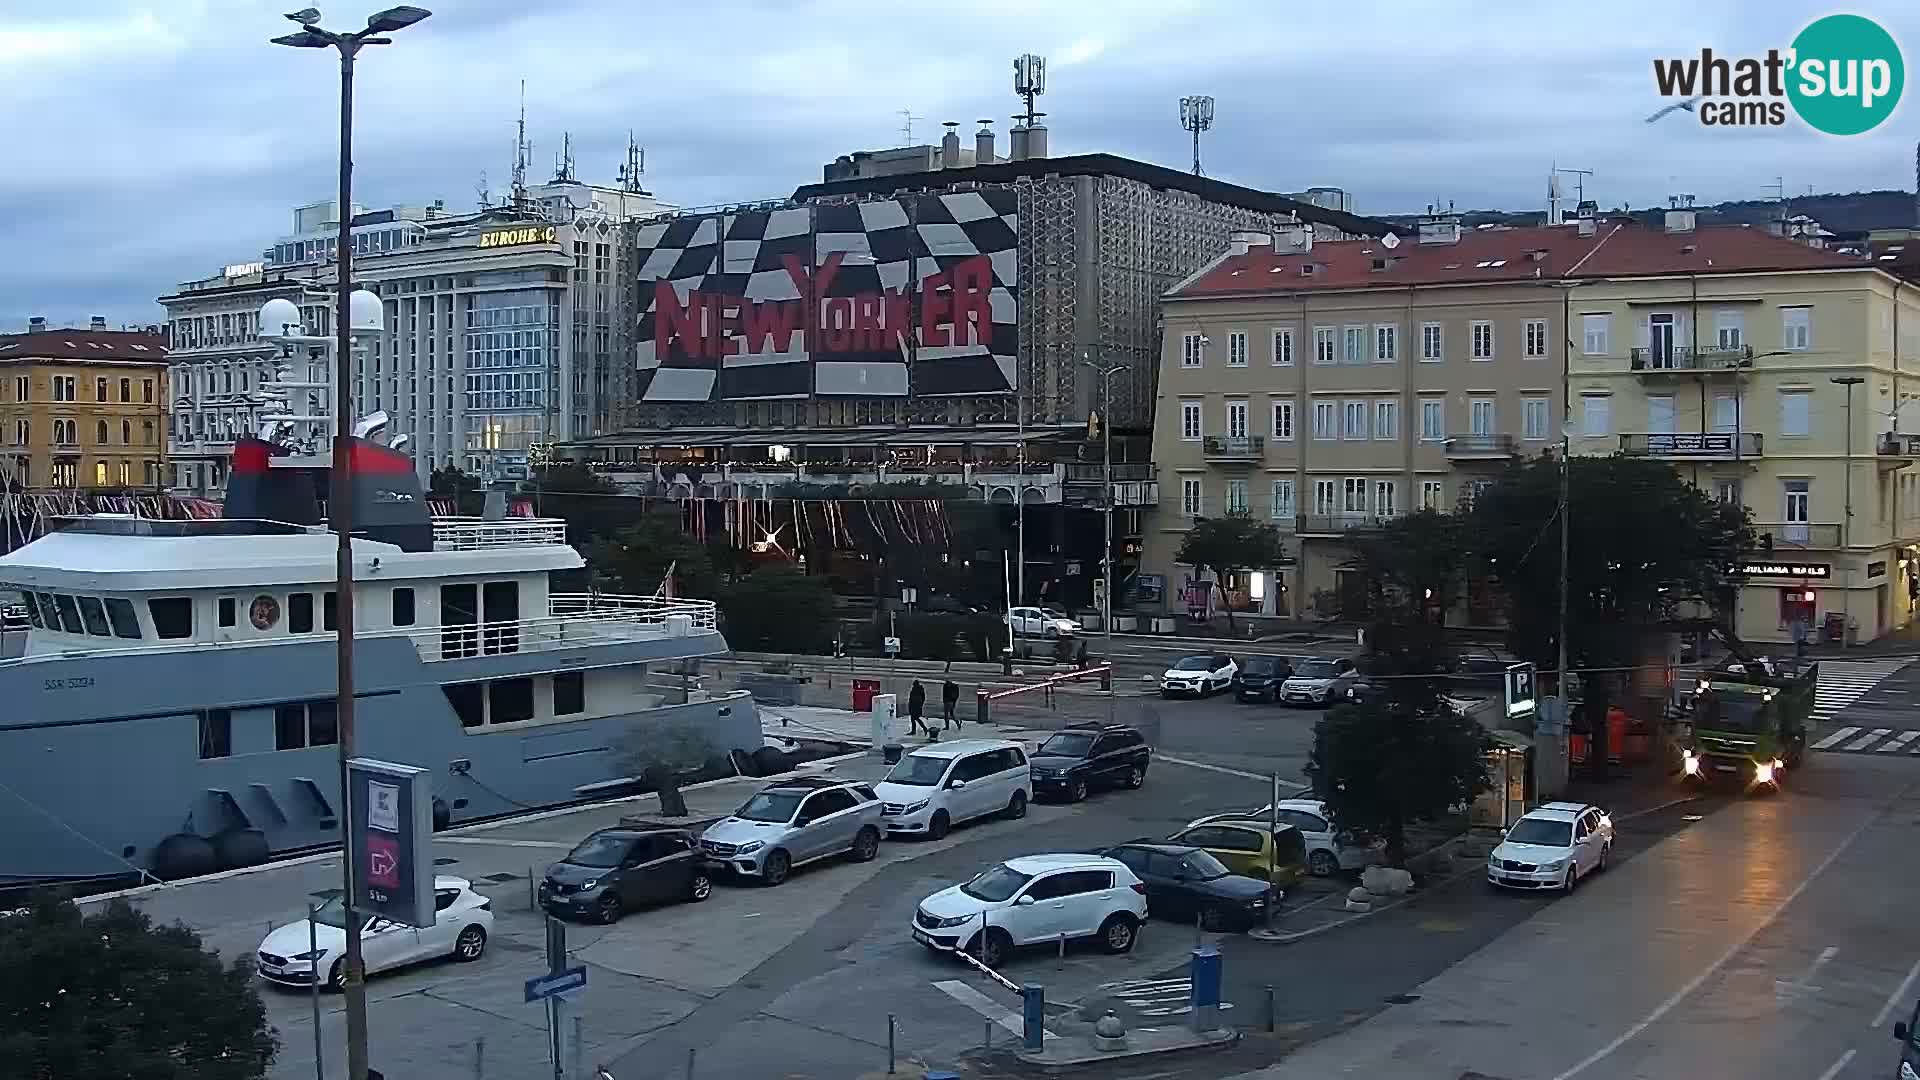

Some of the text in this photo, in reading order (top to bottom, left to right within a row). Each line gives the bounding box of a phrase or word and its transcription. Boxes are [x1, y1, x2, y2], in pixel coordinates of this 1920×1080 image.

[656, 252, 993, 361] NEW YORKER
[1516, 673, 1528, 694] P
